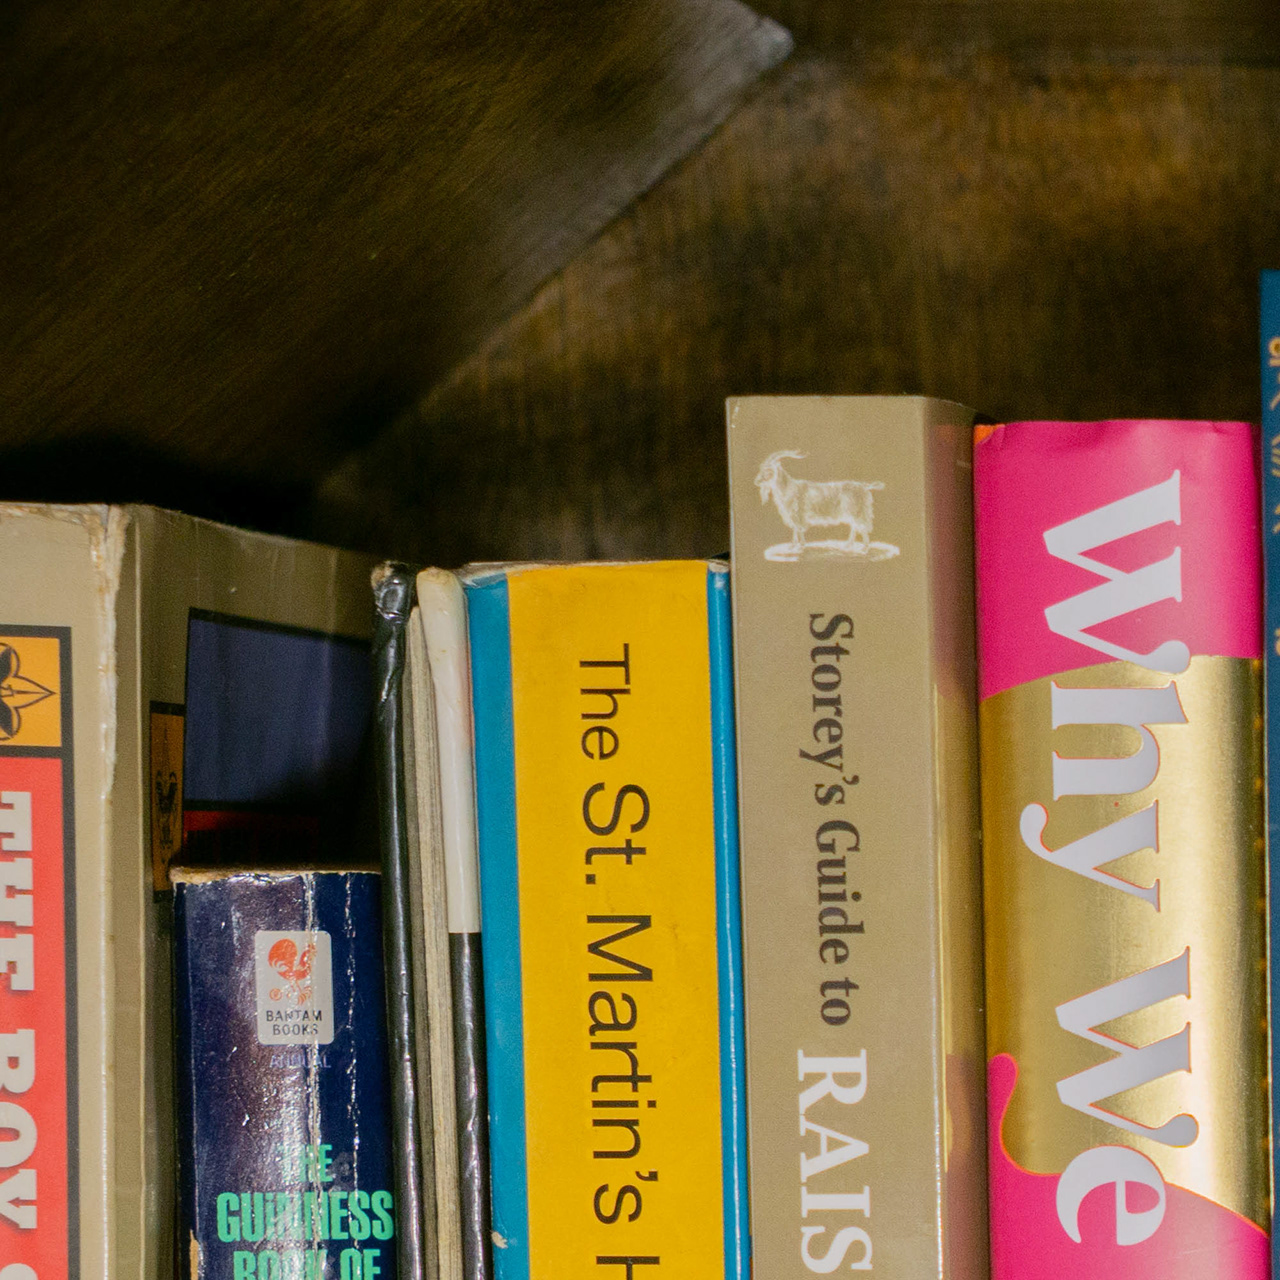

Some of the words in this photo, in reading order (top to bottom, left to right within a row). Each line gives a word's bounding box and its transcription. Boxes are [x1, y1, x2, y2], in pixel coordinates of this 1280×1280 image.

[578, 643, 633, 762] The
[799, 613, 860, 808] Storey's
[1020, 469, 1191, 912] Why
[581, 782, 651, 886] St.
[815, 820, 866, 965] Guide
[266, 1009, 323, 1022] BANTAM
[272, 1023, 319, 1036] BOOKS
[820, 976, 860, 1028] to
[587, 914, 660, 1226] Martin's
[1055, 945, 1200, 1246] We
